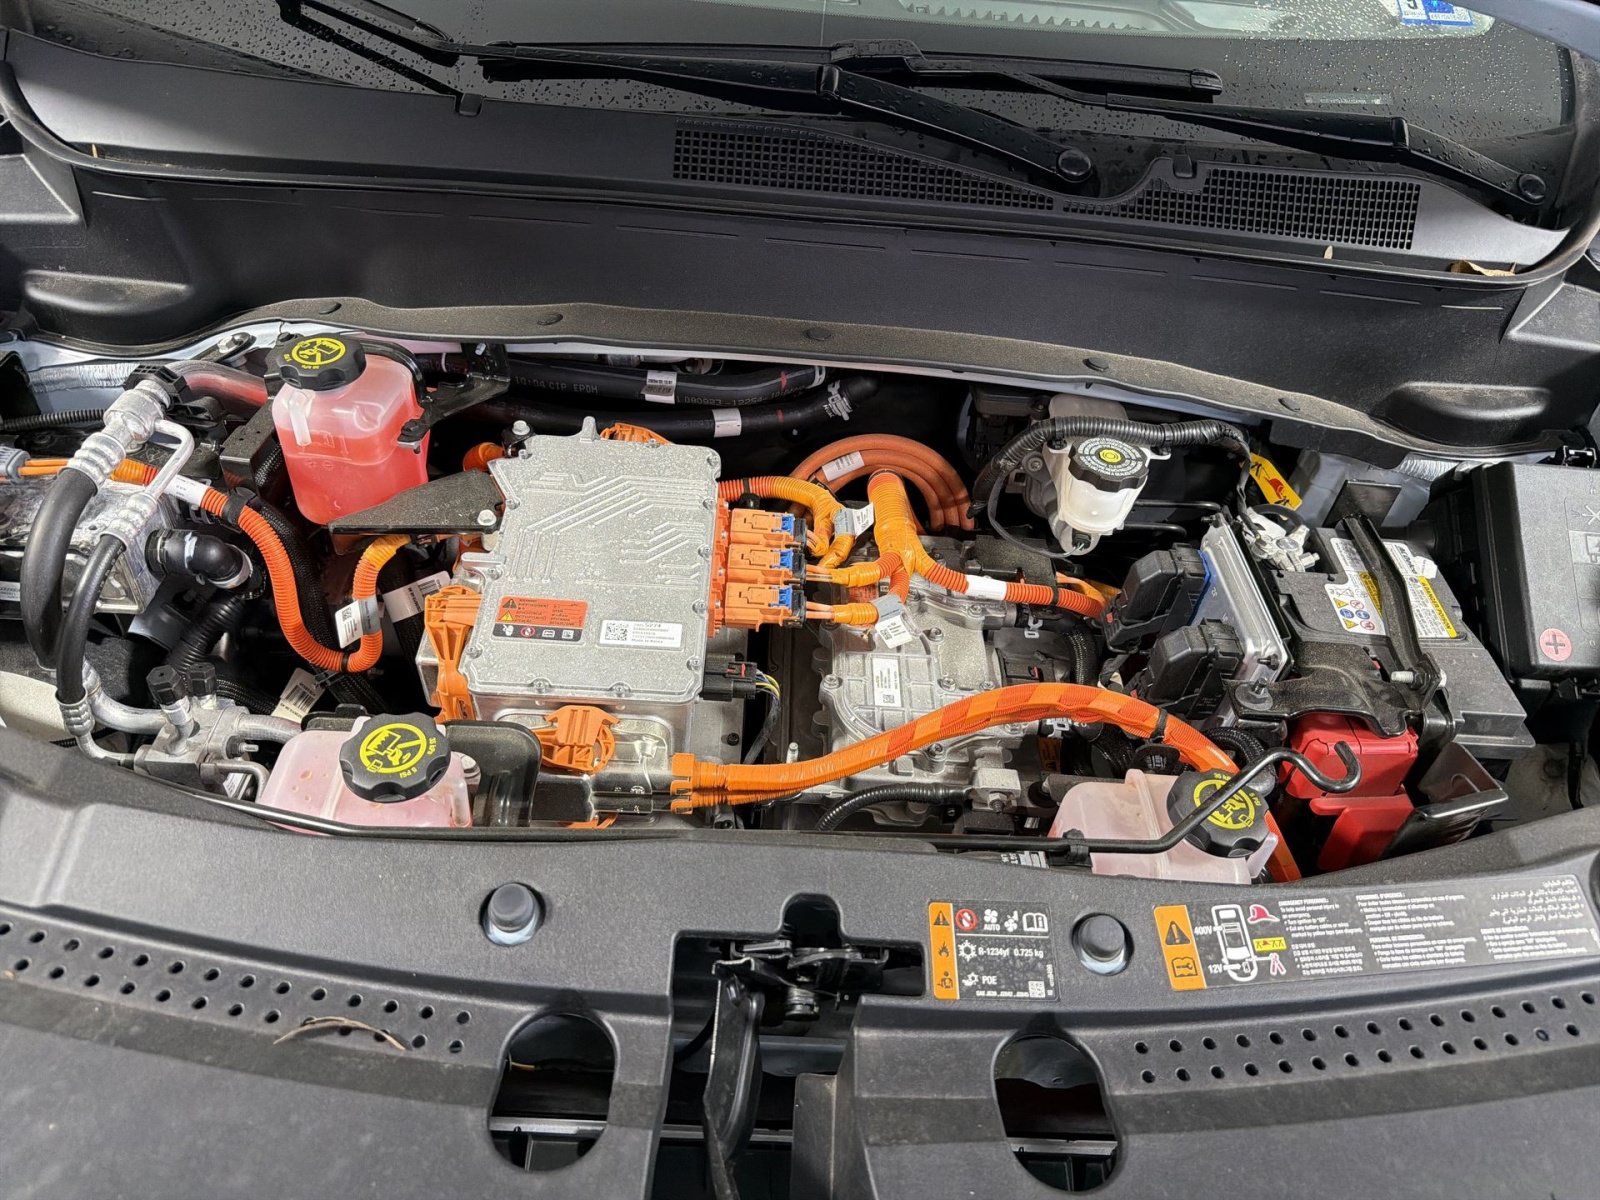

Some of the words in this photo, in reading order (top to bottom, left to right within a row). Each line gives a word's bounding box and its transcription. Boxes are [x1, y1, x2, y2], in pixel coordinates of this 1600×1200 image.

[1194, 926, 1212, 935] 400V
[978, 947, 1010, 957] R-1234yf
[1014, 948, 1033, 956] 0.725
[1034, 949, 1044, 958] kg
[1208, 964, 1222, 974] 12V
[982, 976, 997, 985] POE
